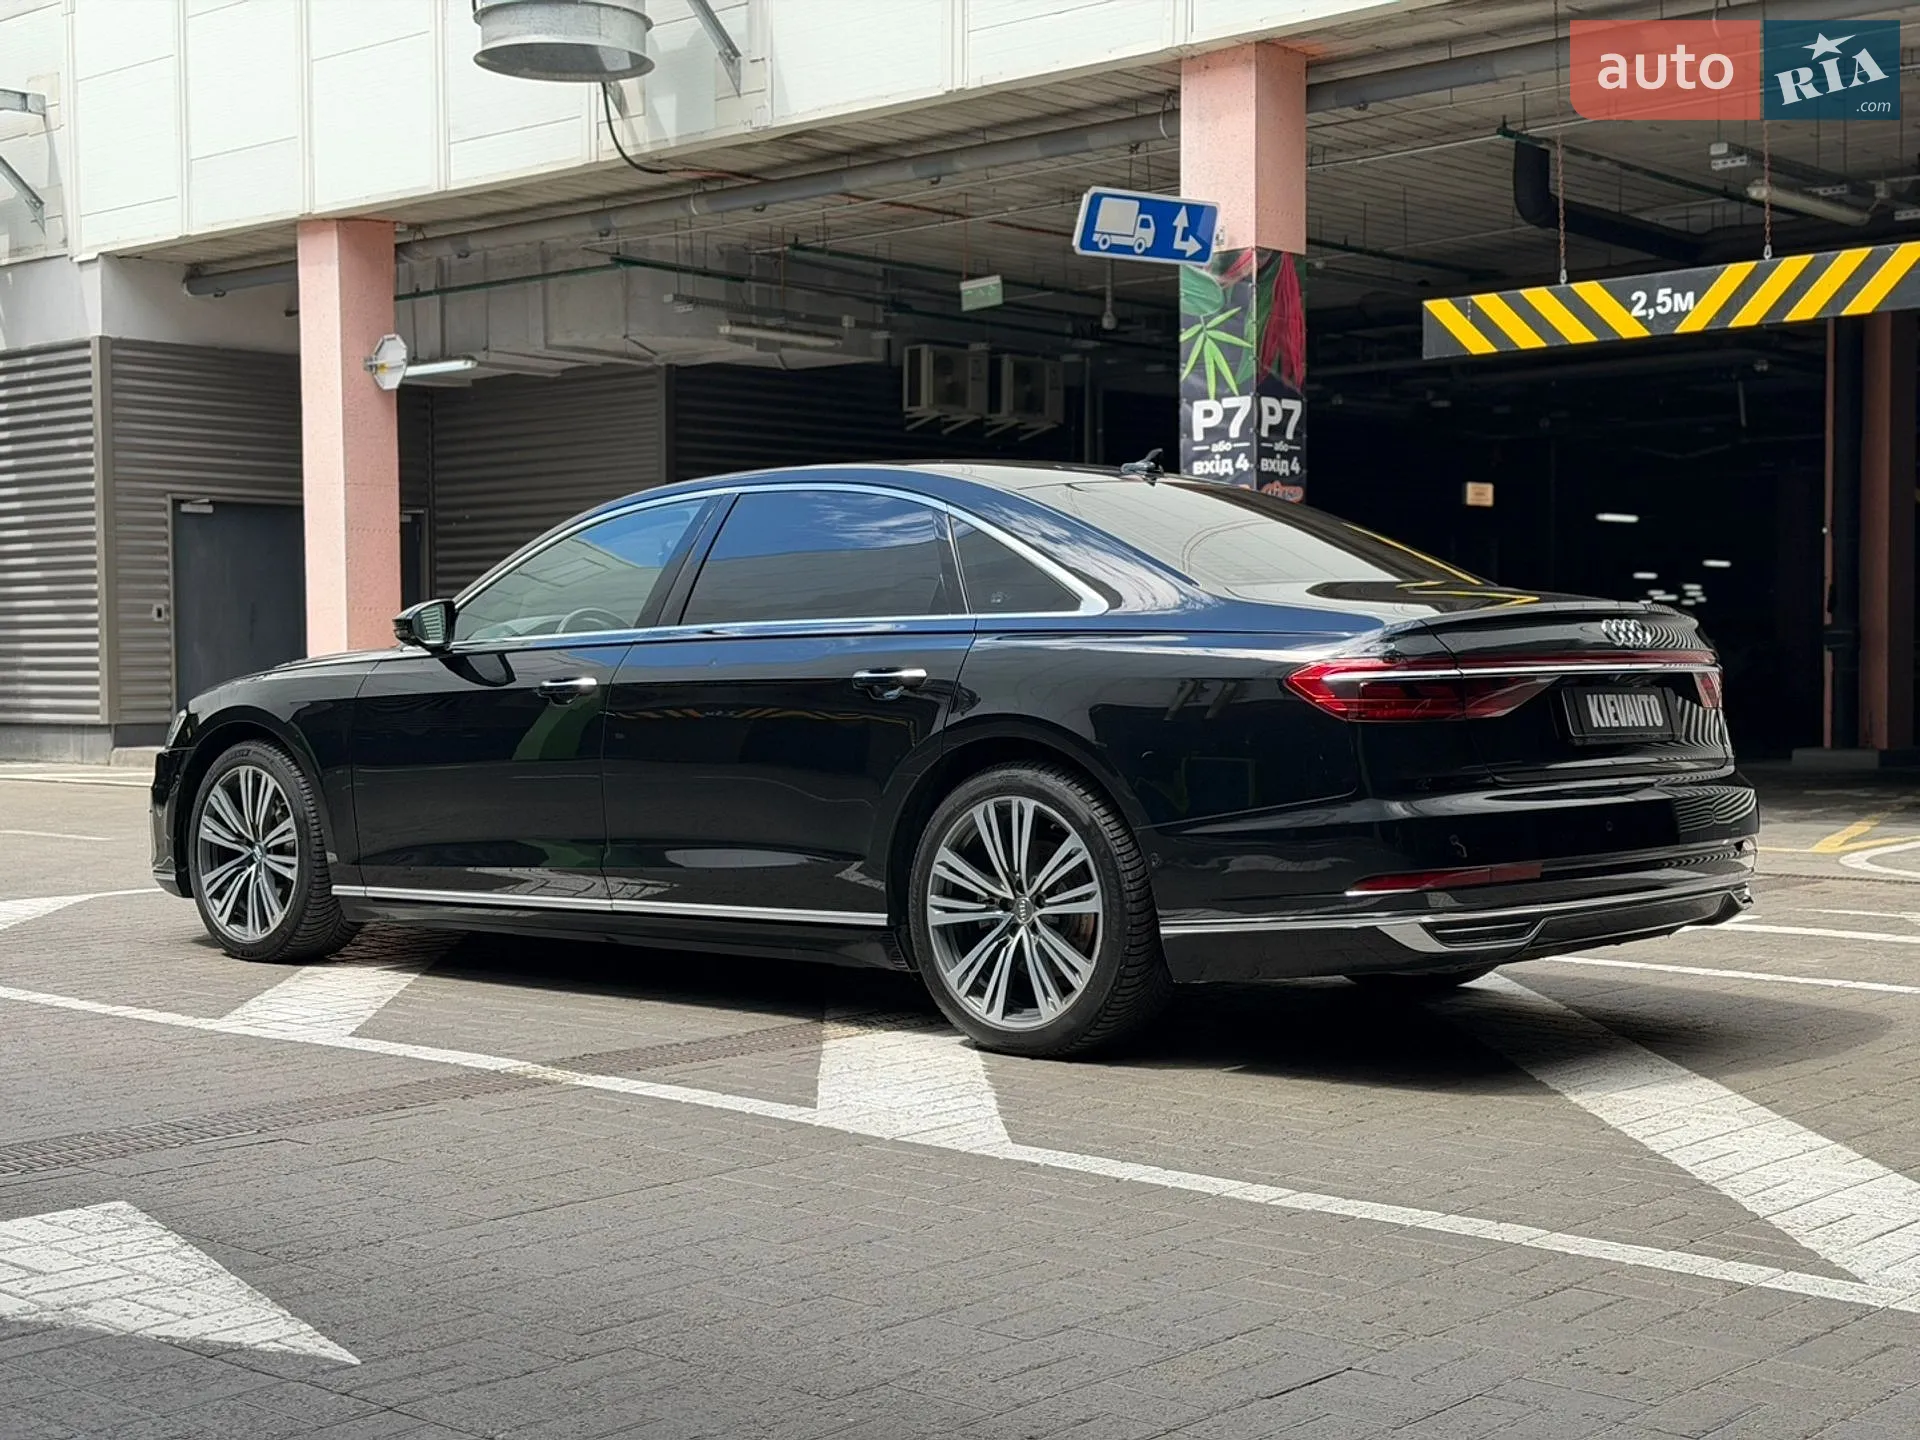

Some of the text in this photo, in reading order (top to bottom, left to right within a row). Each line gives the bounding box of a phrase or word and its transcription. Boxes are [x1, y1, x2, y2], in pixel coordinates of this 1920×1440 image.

[1192, 396, 1252, 442] P7
[1260, 396, 1302, 440] P7
[1211, 440, 1233, 453] або
[1193, 453, 1249, 477] вхід 4
[1261, 453, 1301, 477] вхід 4
[1586, 694, 1664, 728] KIEVAUTO
